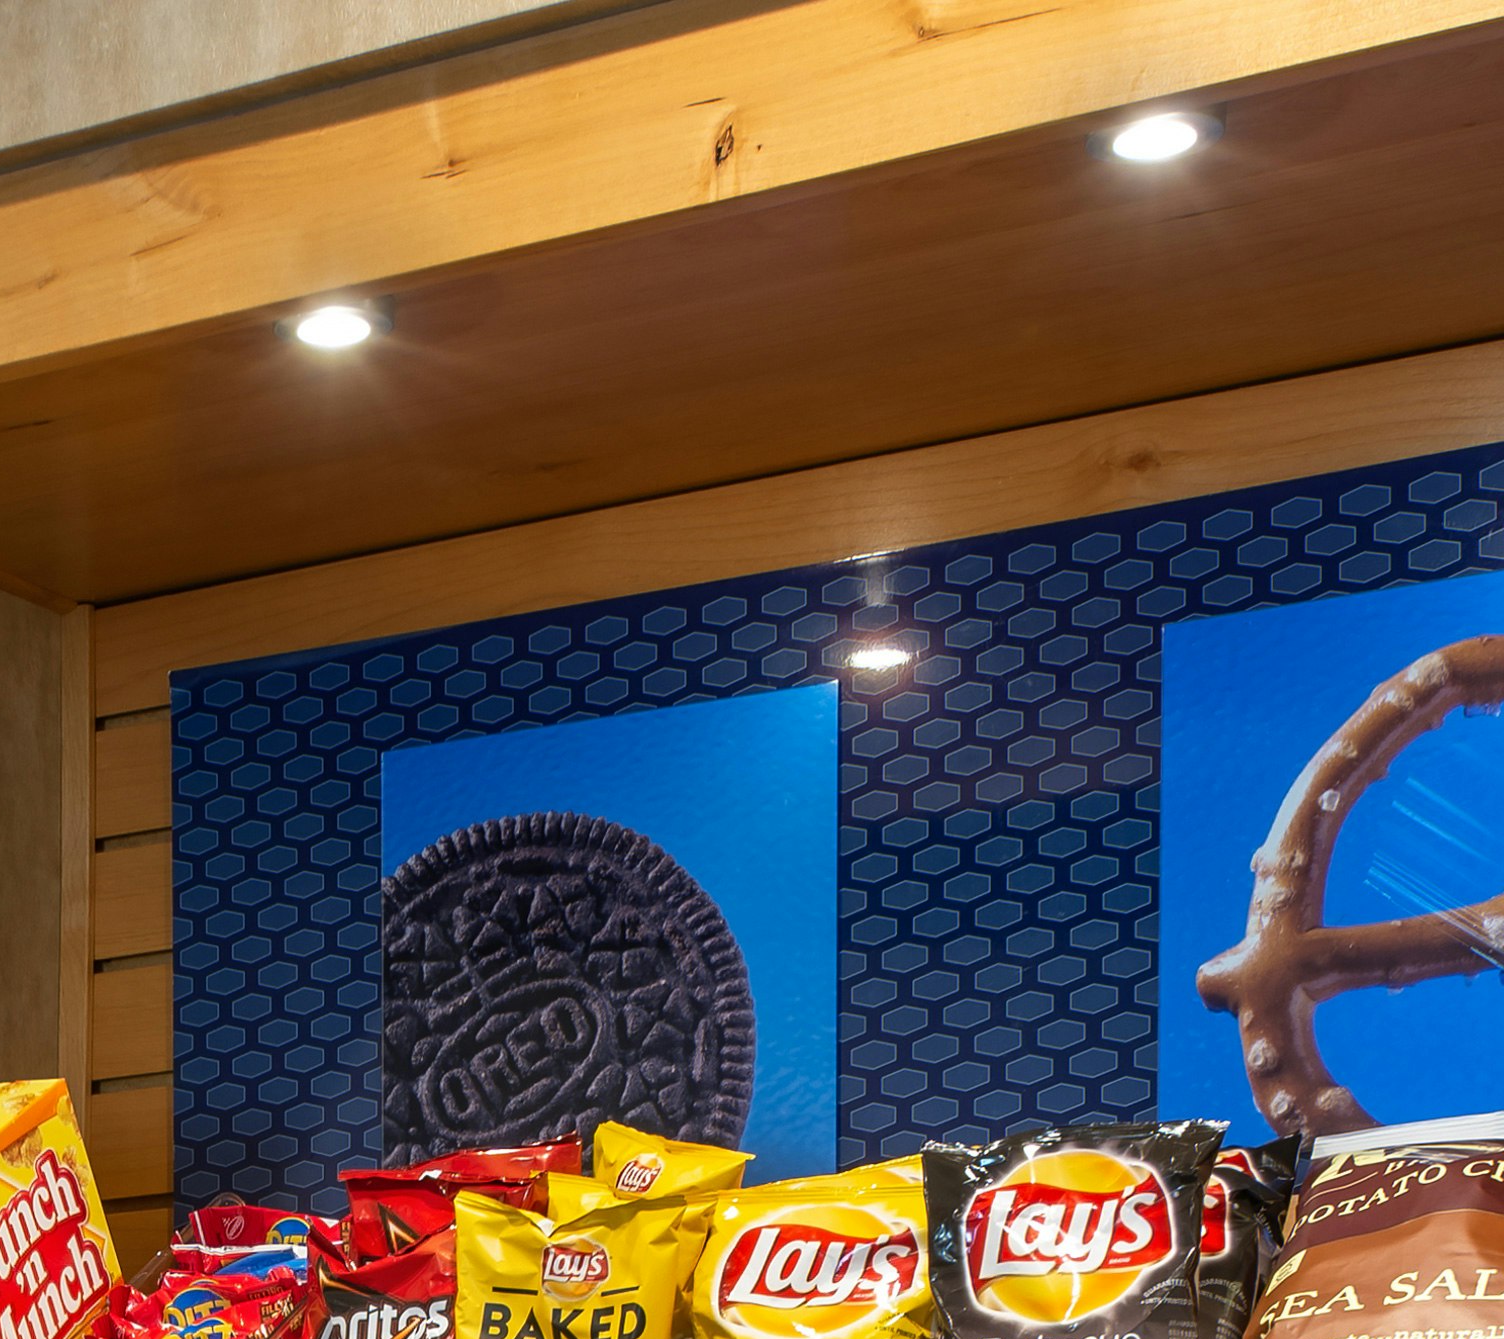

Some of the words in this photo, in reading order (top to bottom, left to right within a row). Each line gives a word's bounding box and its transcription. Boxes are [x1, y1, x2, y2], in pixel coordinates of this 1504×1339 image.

[979, 1186, 1158, 1280] Lay's
[1290, 1162, 1448, 1240] POTATO
[727, 1226, 911, 1308] Lay's
